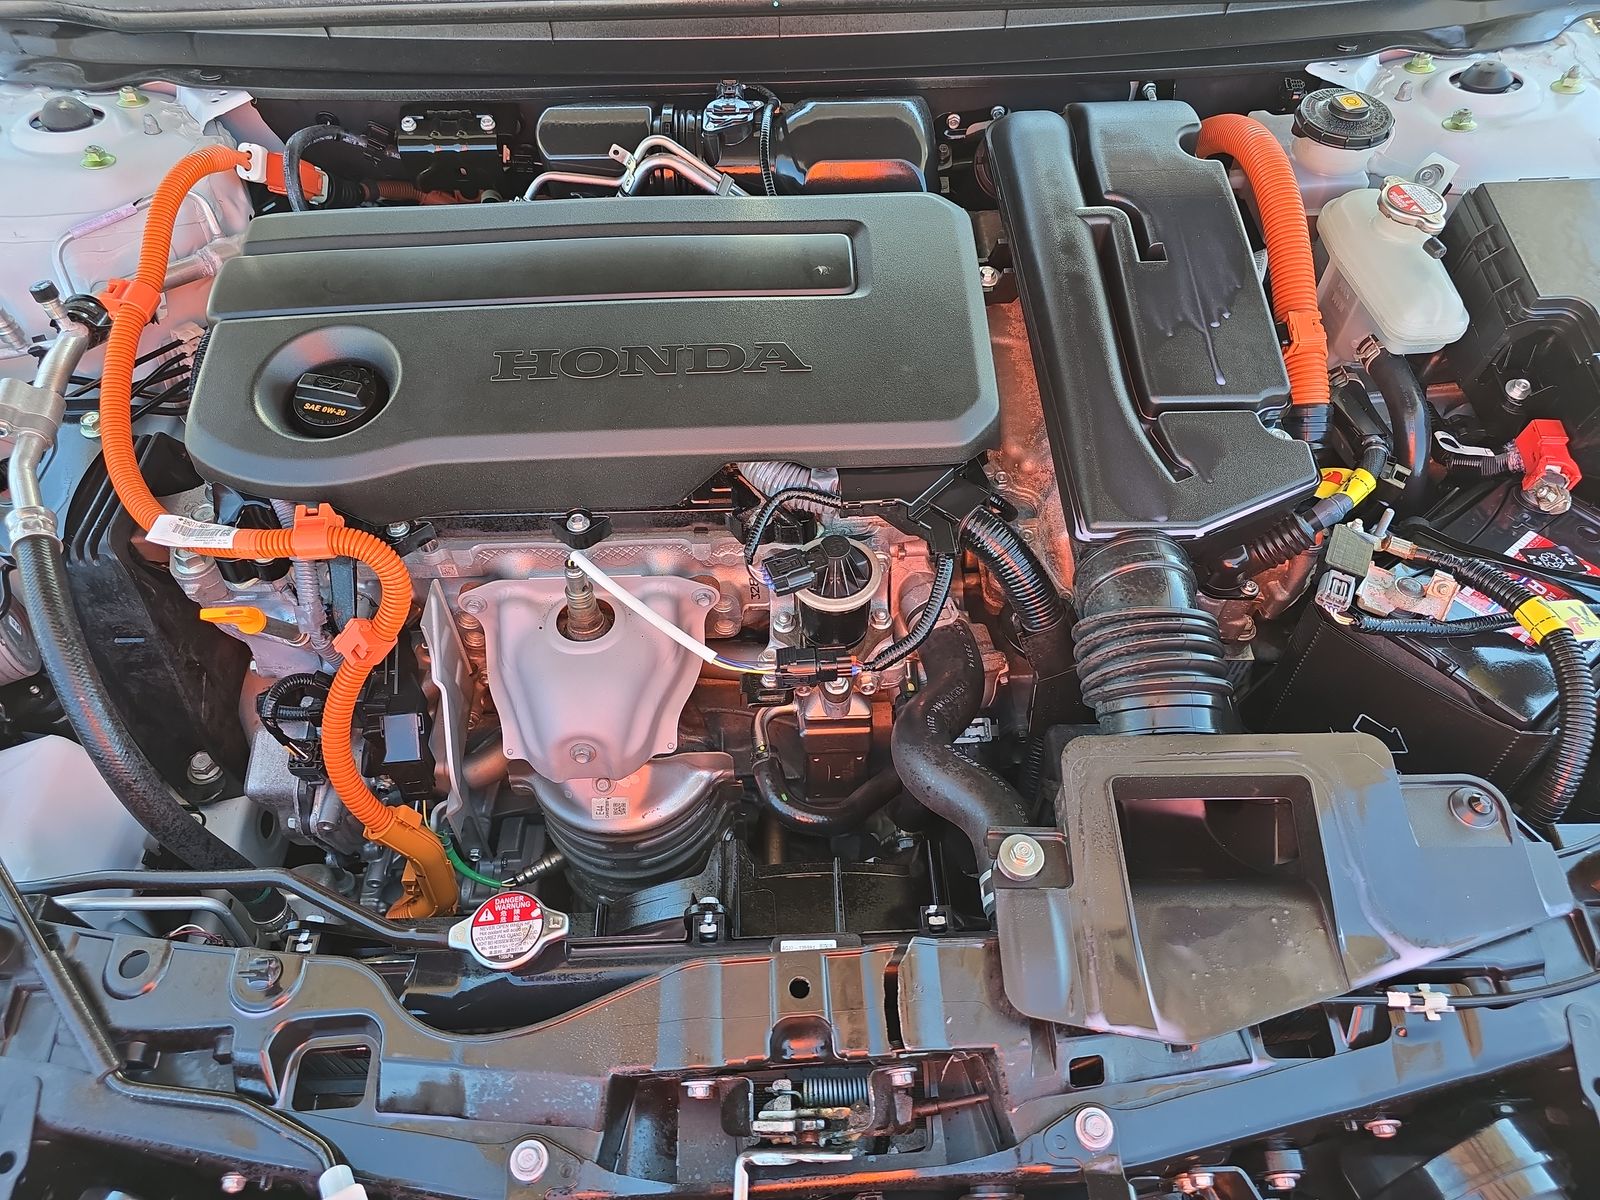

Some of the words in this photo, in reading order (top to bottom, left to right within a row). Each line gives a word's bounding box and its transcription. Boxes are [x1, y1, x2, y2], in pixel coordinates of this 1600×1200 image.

[490, 341, 813, 382] HONDA
[303, 402, 321, 412] SAE
[321, 406, 347, 417] 0W-20
[494, 895, 525, 905] DANGER
[494, 901, 531, 912] WARNUNG
